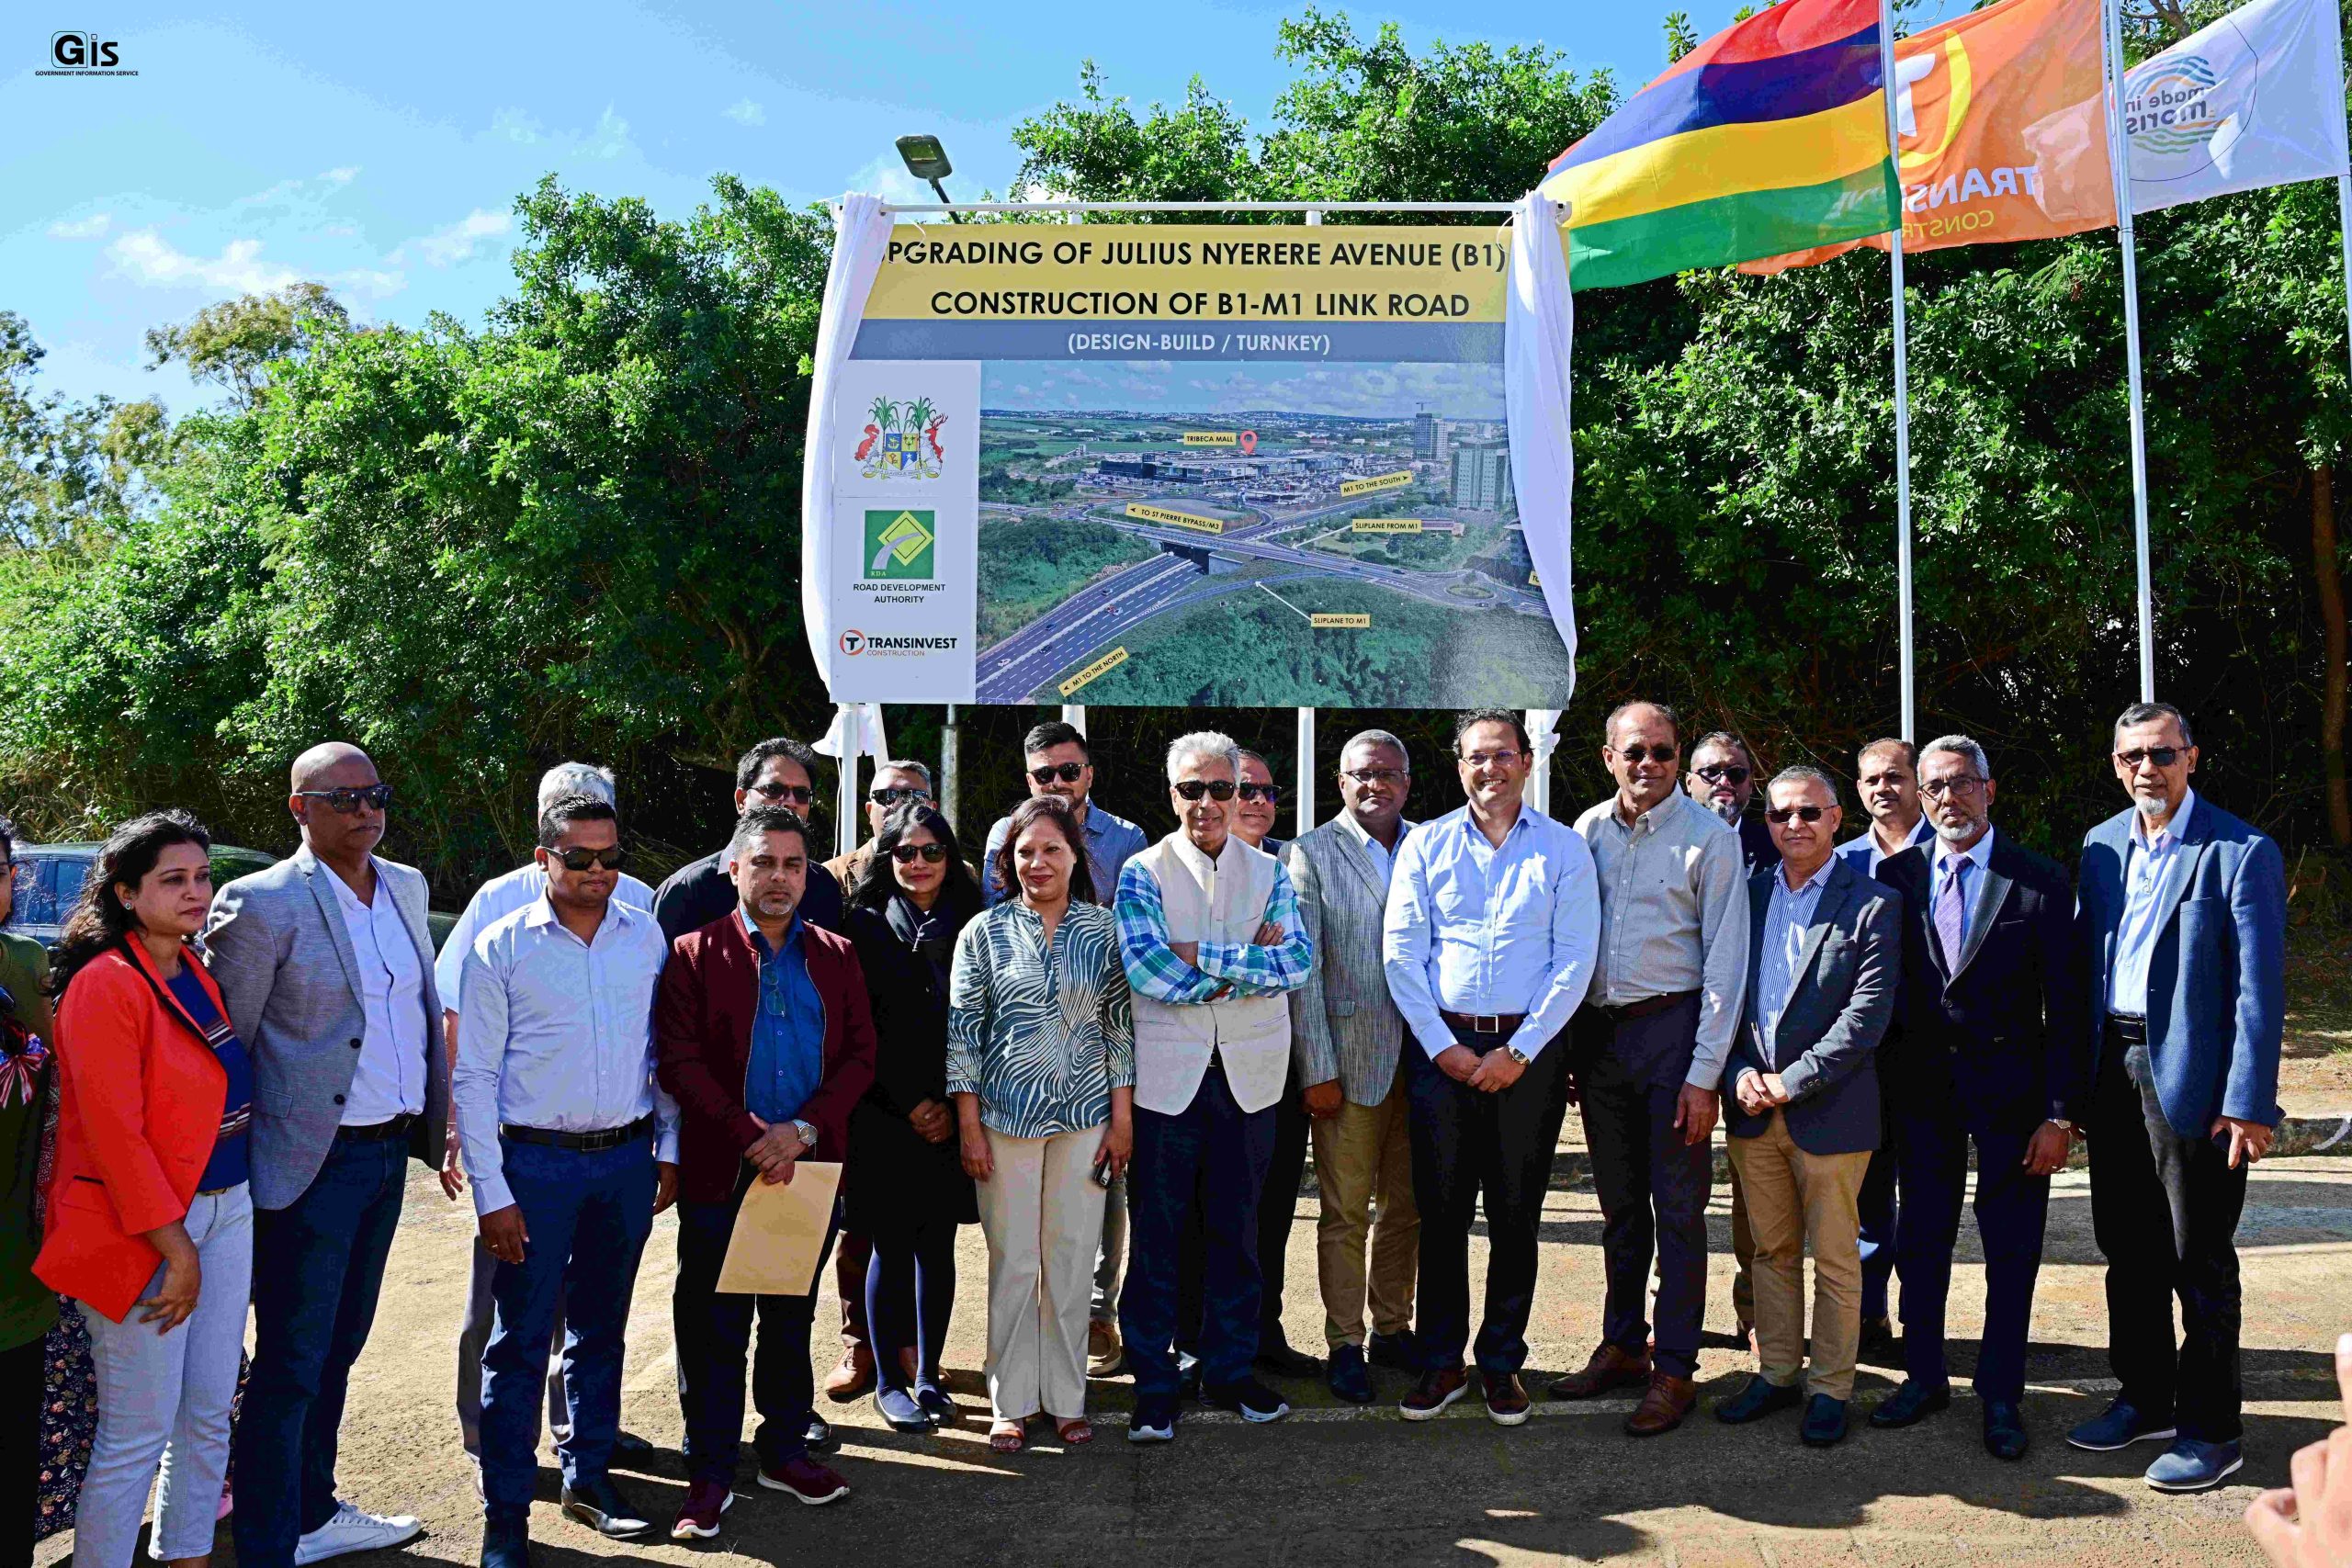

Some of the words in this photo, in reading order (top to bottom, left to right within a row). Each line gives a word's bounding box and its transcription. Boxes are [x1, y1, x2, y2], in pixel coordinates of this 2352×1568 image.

[882, 242, 1044, 265] PGRADING
[1053, 242, 1092, 265] OF
[1101, 243, 1192, 265] JULIUS
[1202, 243, 1321, 265] NYERERE
[1329, 243, 1442, 266] AVENUE
[1452, 243, 1506, 273] (B1)
[931, 291, 1158, 315] CONSTRUCTION
[1169, 291, 1208, 315] OF
[1218, 292, 1302, 315] B1-M1
[1316, 293, 1378, 316] LINK
[1388, 293, 1470, 317] ROAD
[1068, 333, 1216, 355] (DESIGN-BUILD
[1222, 334, 1231, 352] /
[1237, 334, 1330, 355] TURNKEY)
[1379, 477, 1401, 486] SOUTH
[1159, 512, 1182, 523] PIERRE
[1182, 517, 1220, 530] BYPASS/M3
[874, 595, 925, 604] AUTHORITY
[867, 637, 957, 649] TRANSINVEST
[1072, 677, 1082, 686] M1
[1082, 671, 1091, 680] TO
[1091, 664, 1103, 674] THE
[1103, 650, 1125, 667] NORTH
